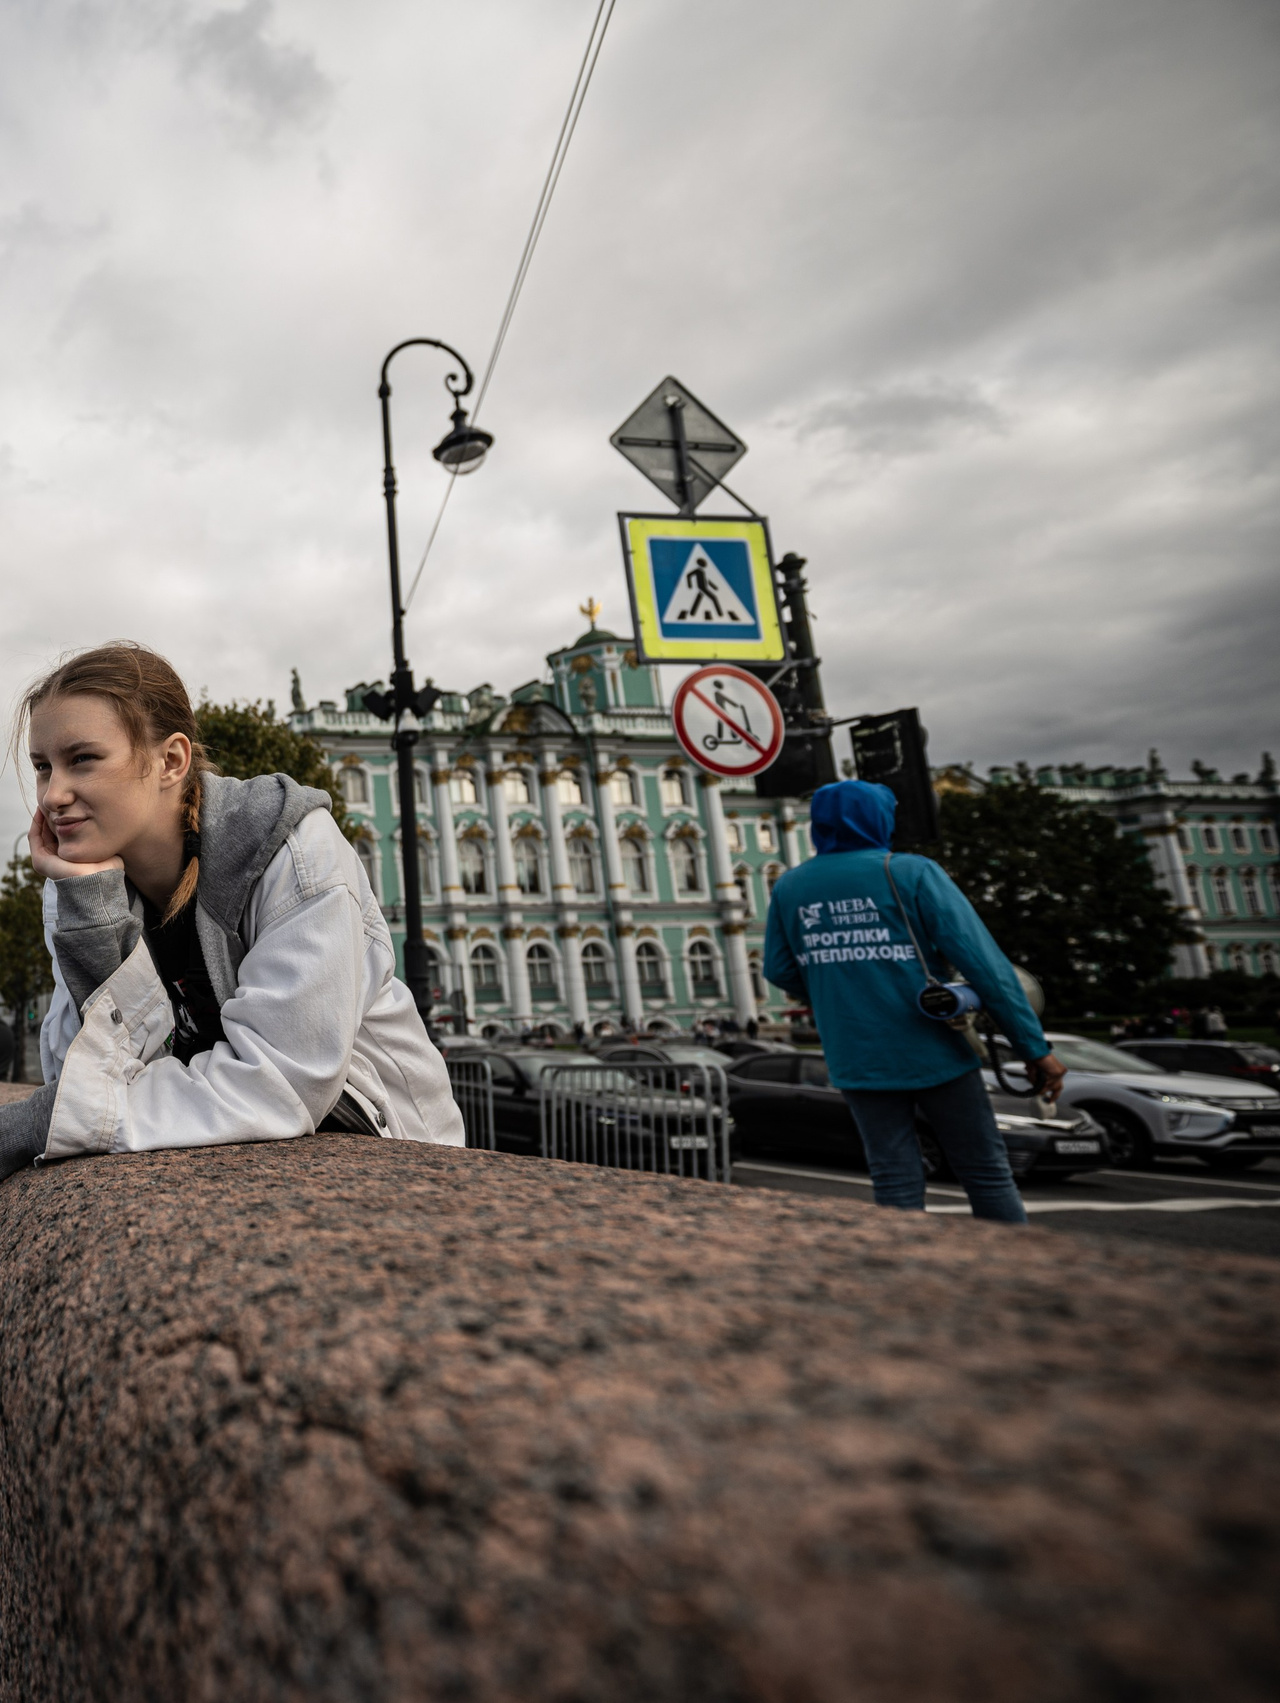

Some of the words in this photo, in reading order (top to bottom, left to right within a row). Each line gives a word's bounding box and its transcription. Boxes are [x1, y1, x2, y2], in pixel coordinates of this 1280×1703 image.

[827, 897, 878, 914] НЕВА
[831, 911, 880, 925] ТРЕВЕЛ
[803, 928, 891, 948] ПРОГУЛКИ
[810, 944, 916, 965] ТЕПЛОХОДЕ
